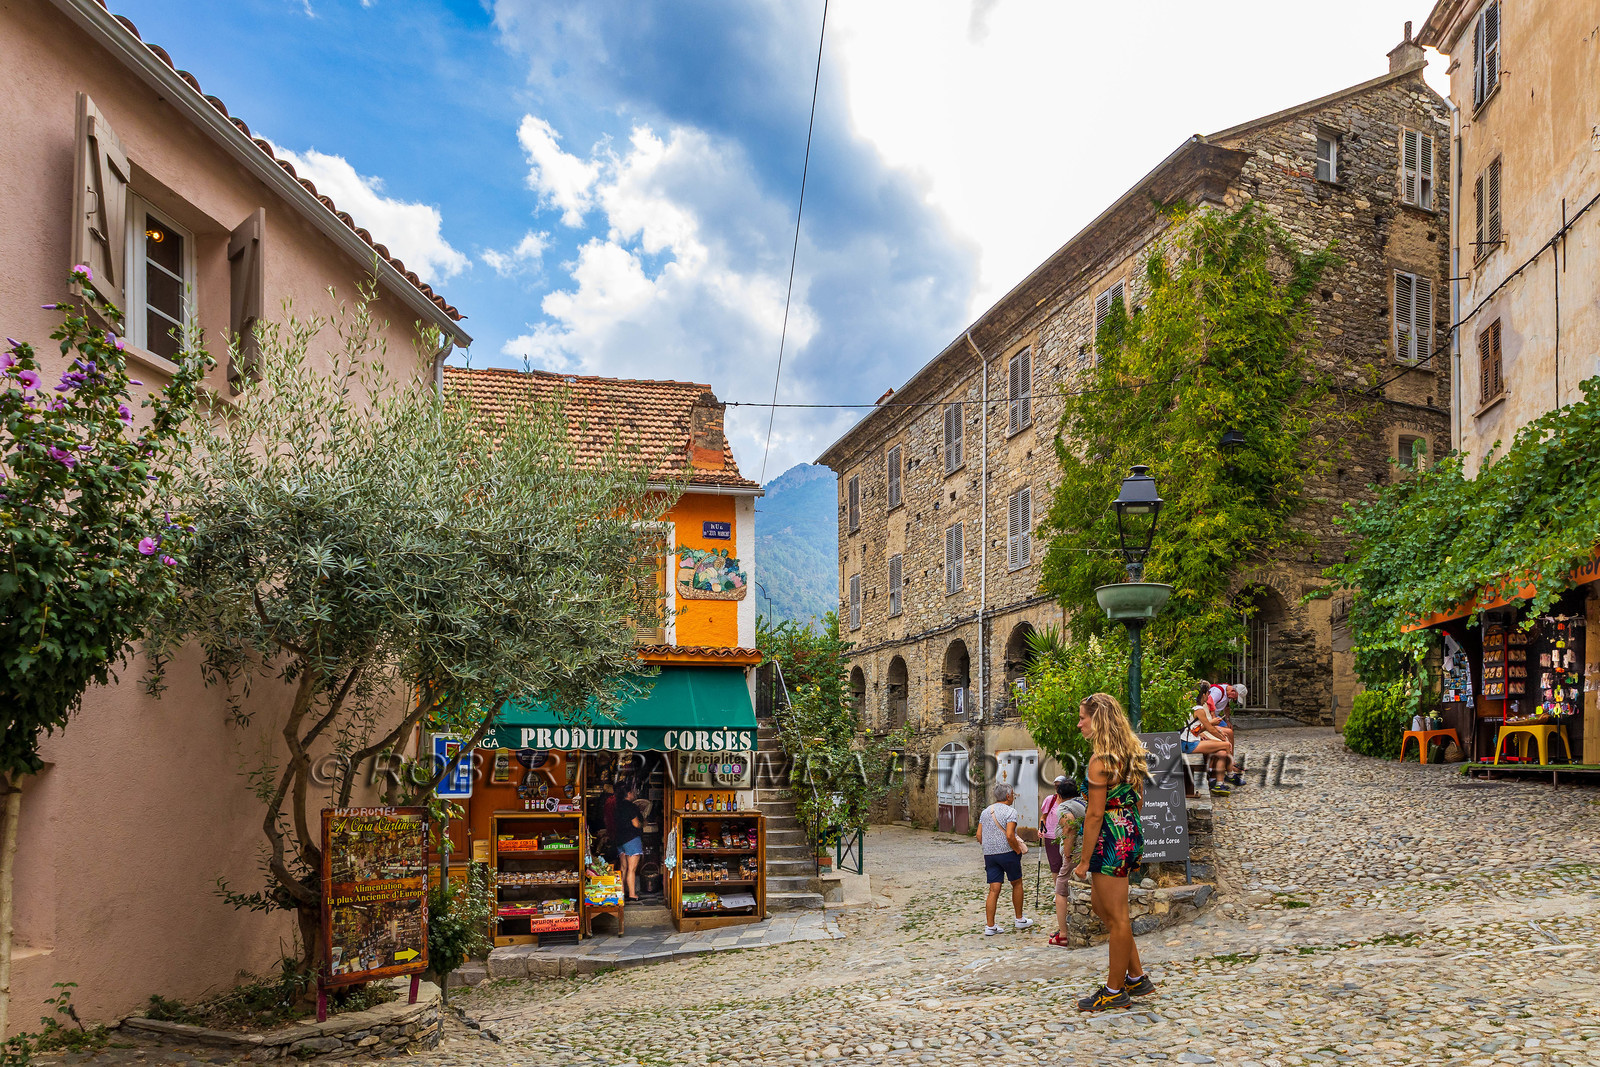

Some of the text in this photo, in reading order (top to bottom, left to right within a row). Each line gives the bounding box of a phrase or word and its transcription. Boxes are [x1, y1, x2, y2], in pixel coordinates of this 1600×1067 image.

[474, 738, 499, 748] NGA
[520, 728, 752, 750] PRODUITS CORSES
[689, 770, 704, 782] du
[334, 806, 398, 817] HYDROMEL
[350, 817, 374, 832] Casa
[1165, 836, 1180, 844] Corse
[353, 882, 402, 893] Alimentation
[327, 889, 426, 906] la plus Ancienne d'Europe
